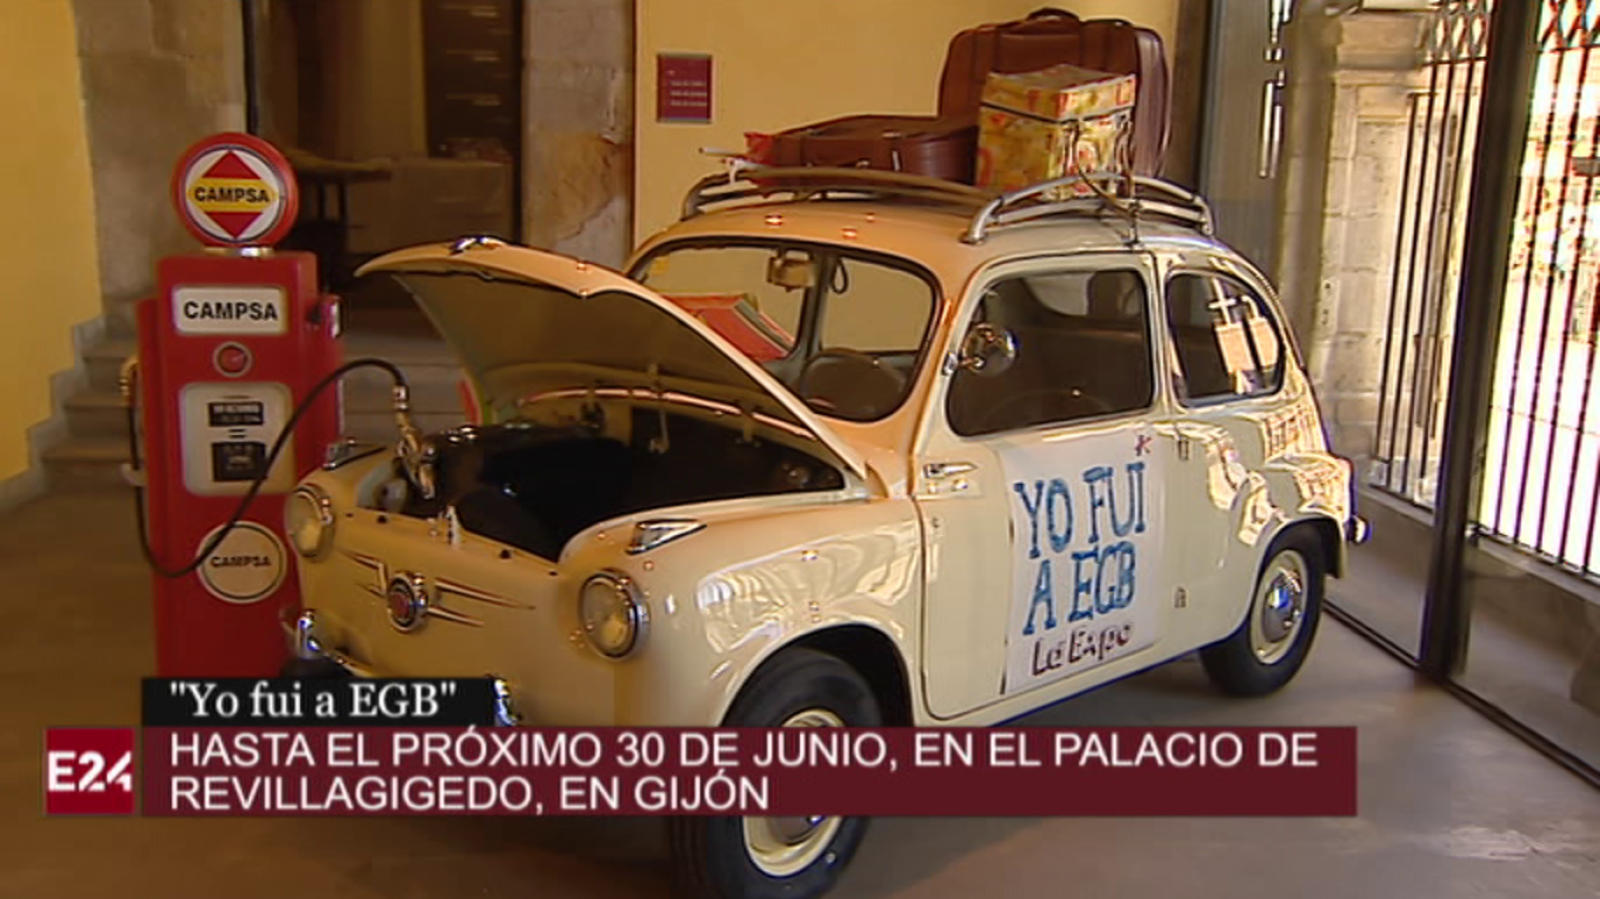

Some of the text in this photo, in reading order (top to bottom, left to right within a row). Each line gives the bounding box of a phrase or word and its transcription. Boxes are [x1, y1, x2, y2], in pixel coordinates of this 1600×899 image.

[194, 187, 271, 203] CAMPSA
[183, 302, 278, 321] CAMPSA
[1013, 462, 1145, 559] YO FUI
[211, 555, 272, 568] CAMPSA
[1023, 541, 1136, 635] A EGB
